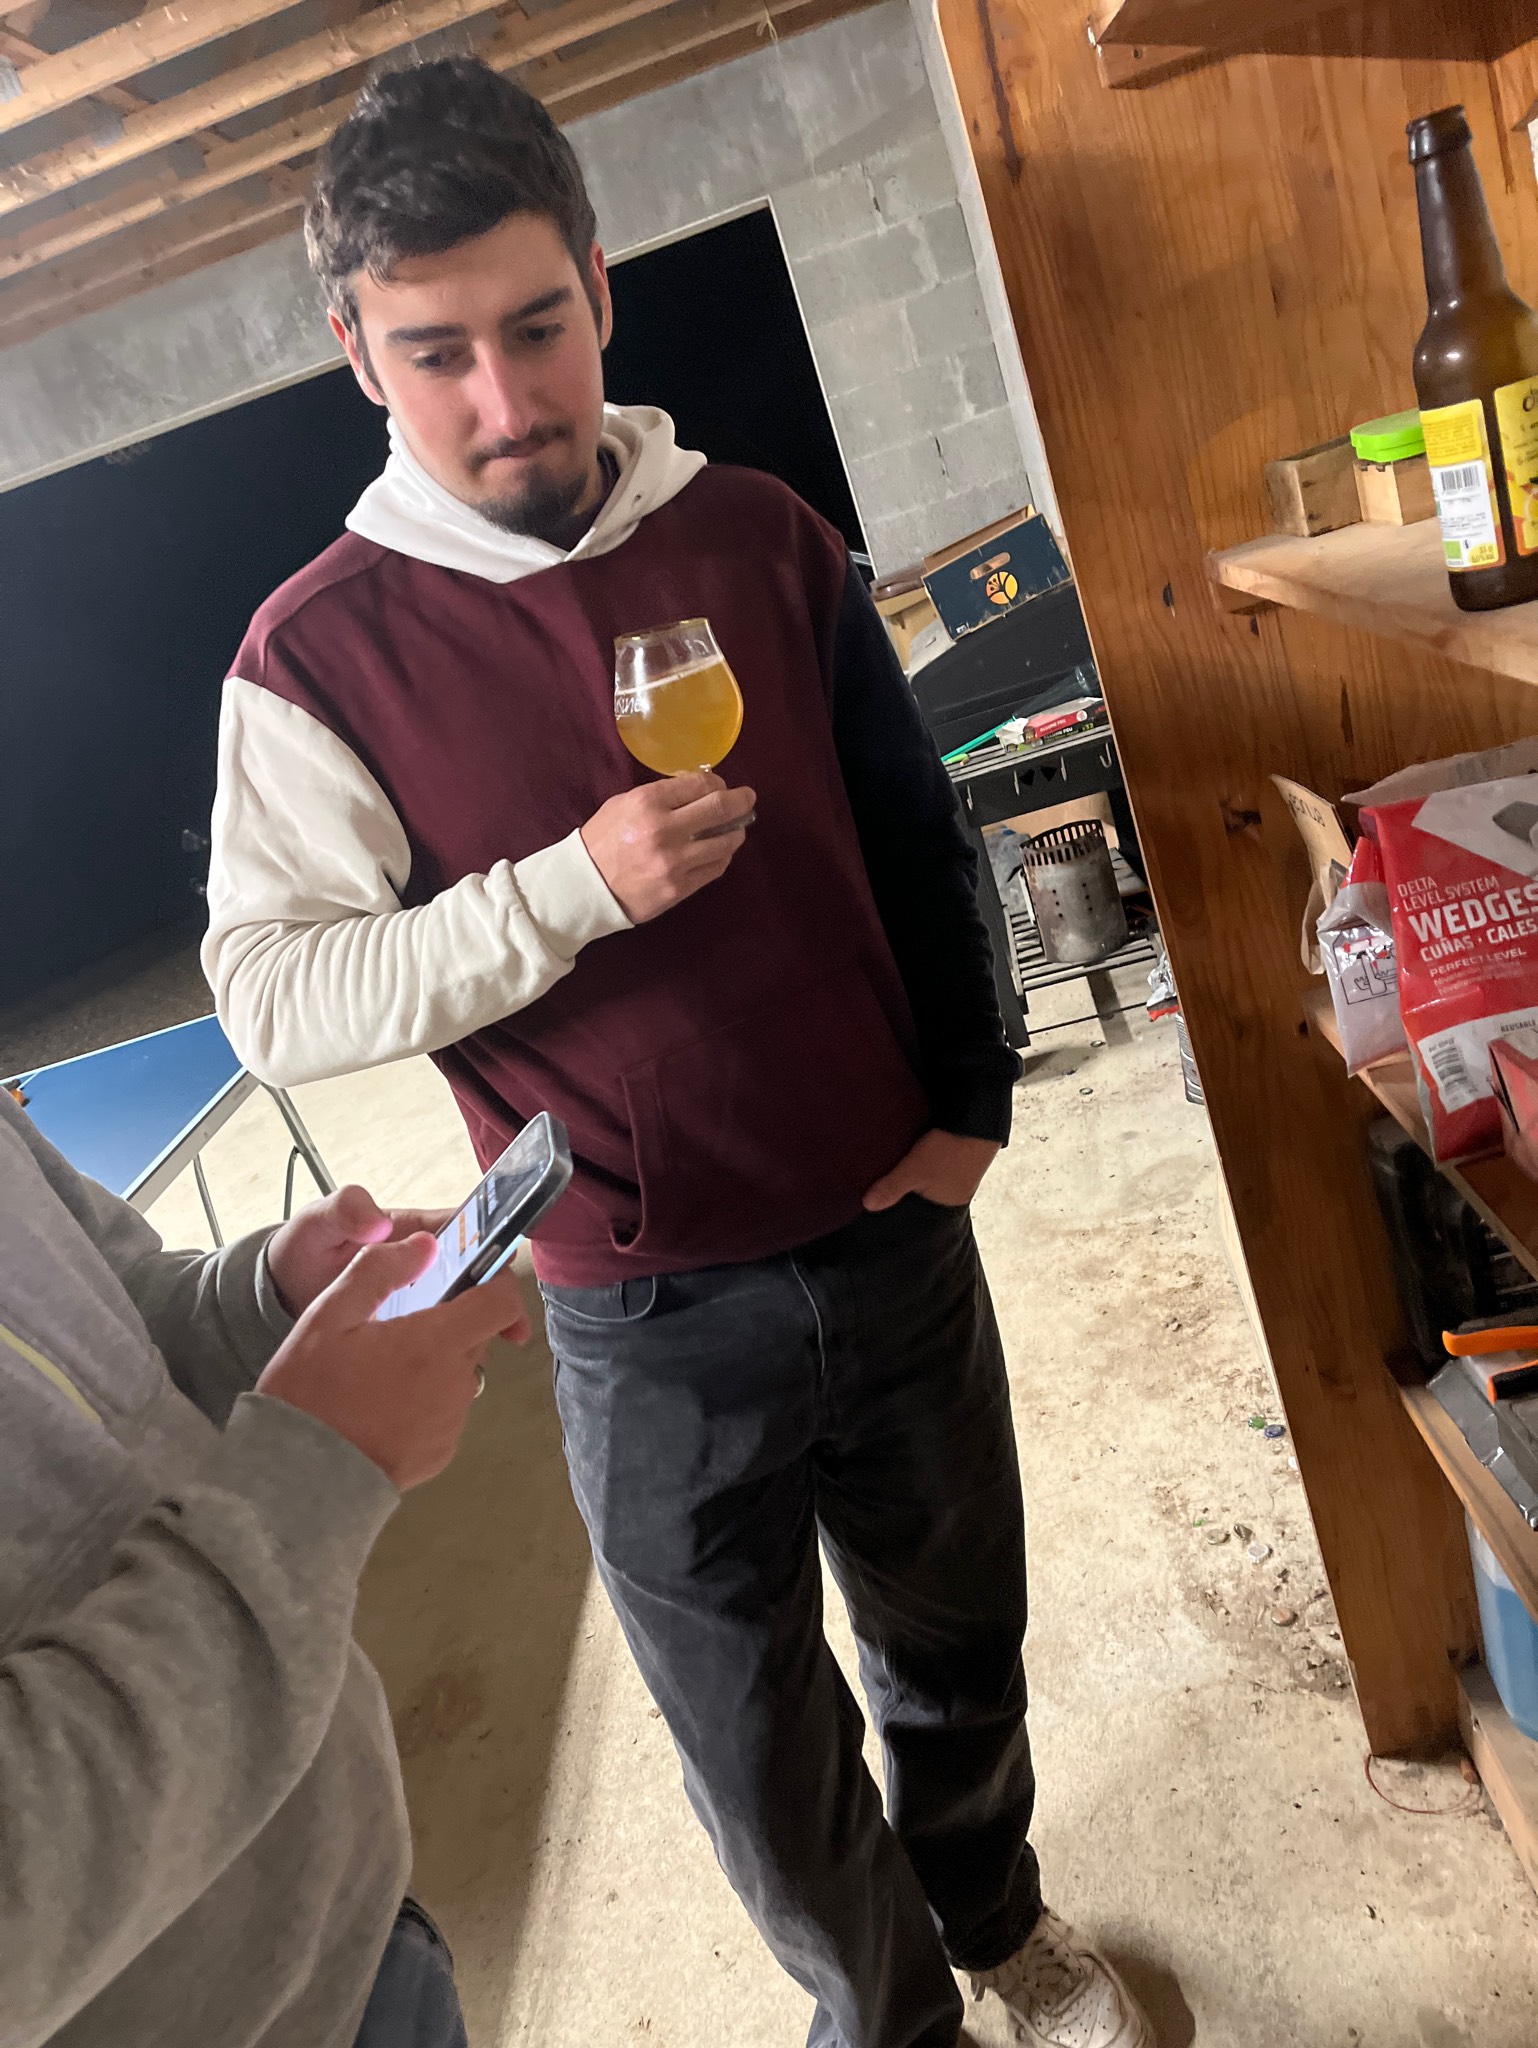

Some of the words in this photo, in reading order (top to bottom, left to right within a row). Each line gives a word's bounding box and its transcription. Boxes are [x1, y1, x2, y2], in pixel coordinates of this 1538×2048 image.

[1397, 876, 1438, 898] DELTA
[1402, 890, 1445, 912] LEVEL
[1444, 875, 1500, 900] SYSTEM
[1408, 882, 1538, 943] WEDGES
[1420, 935, 1474, 962] CUÑAS
[1486, 918, 1538, 944] CALES
[1429, 955, 1483, 977] PERFECT
[1487, 947, 1527, 961] LEVEL
[1500, 1019, 1537, 1033] REUSABLE
